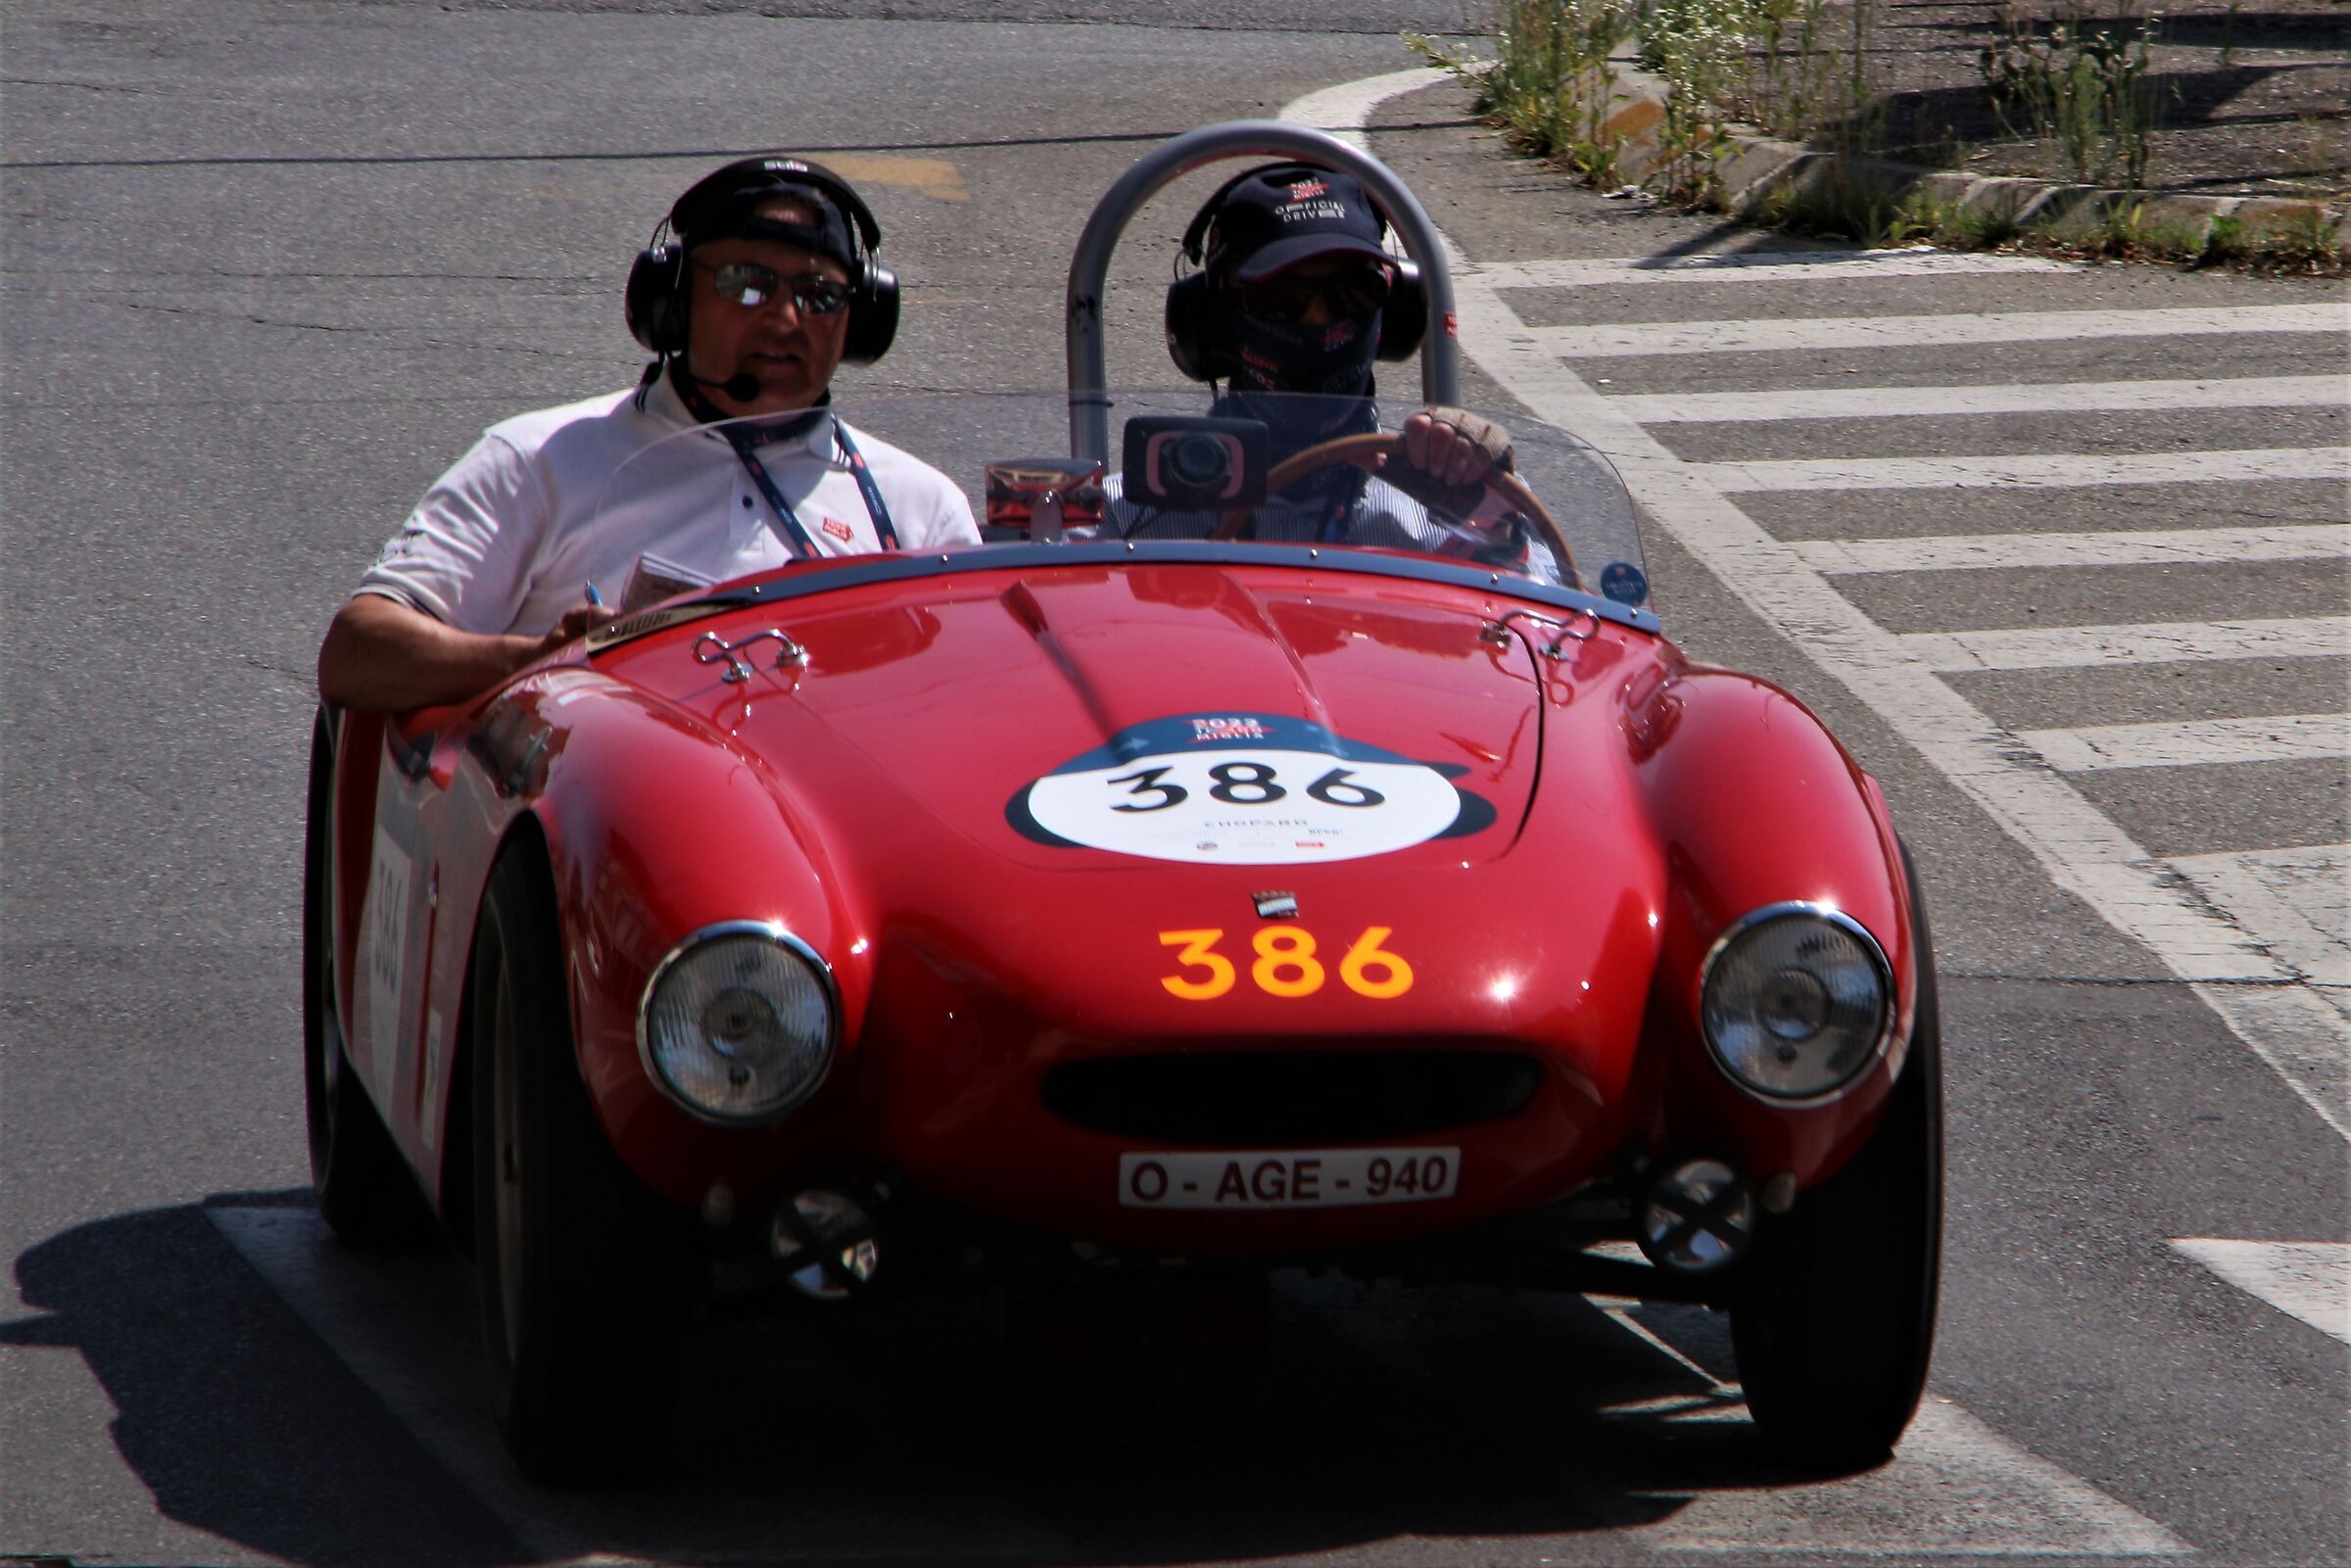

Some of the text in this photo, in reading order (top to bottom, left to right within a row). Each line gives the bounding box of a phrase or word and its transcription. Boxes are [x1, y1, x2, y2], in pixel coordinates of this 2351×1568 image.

[1107, 762, 1385, 813] 386
[1159, 926, 1415, 1000] 386
[1214, 1160, 1321, 1204] AGE
[1367, 1156, 1448, 1198] 940
